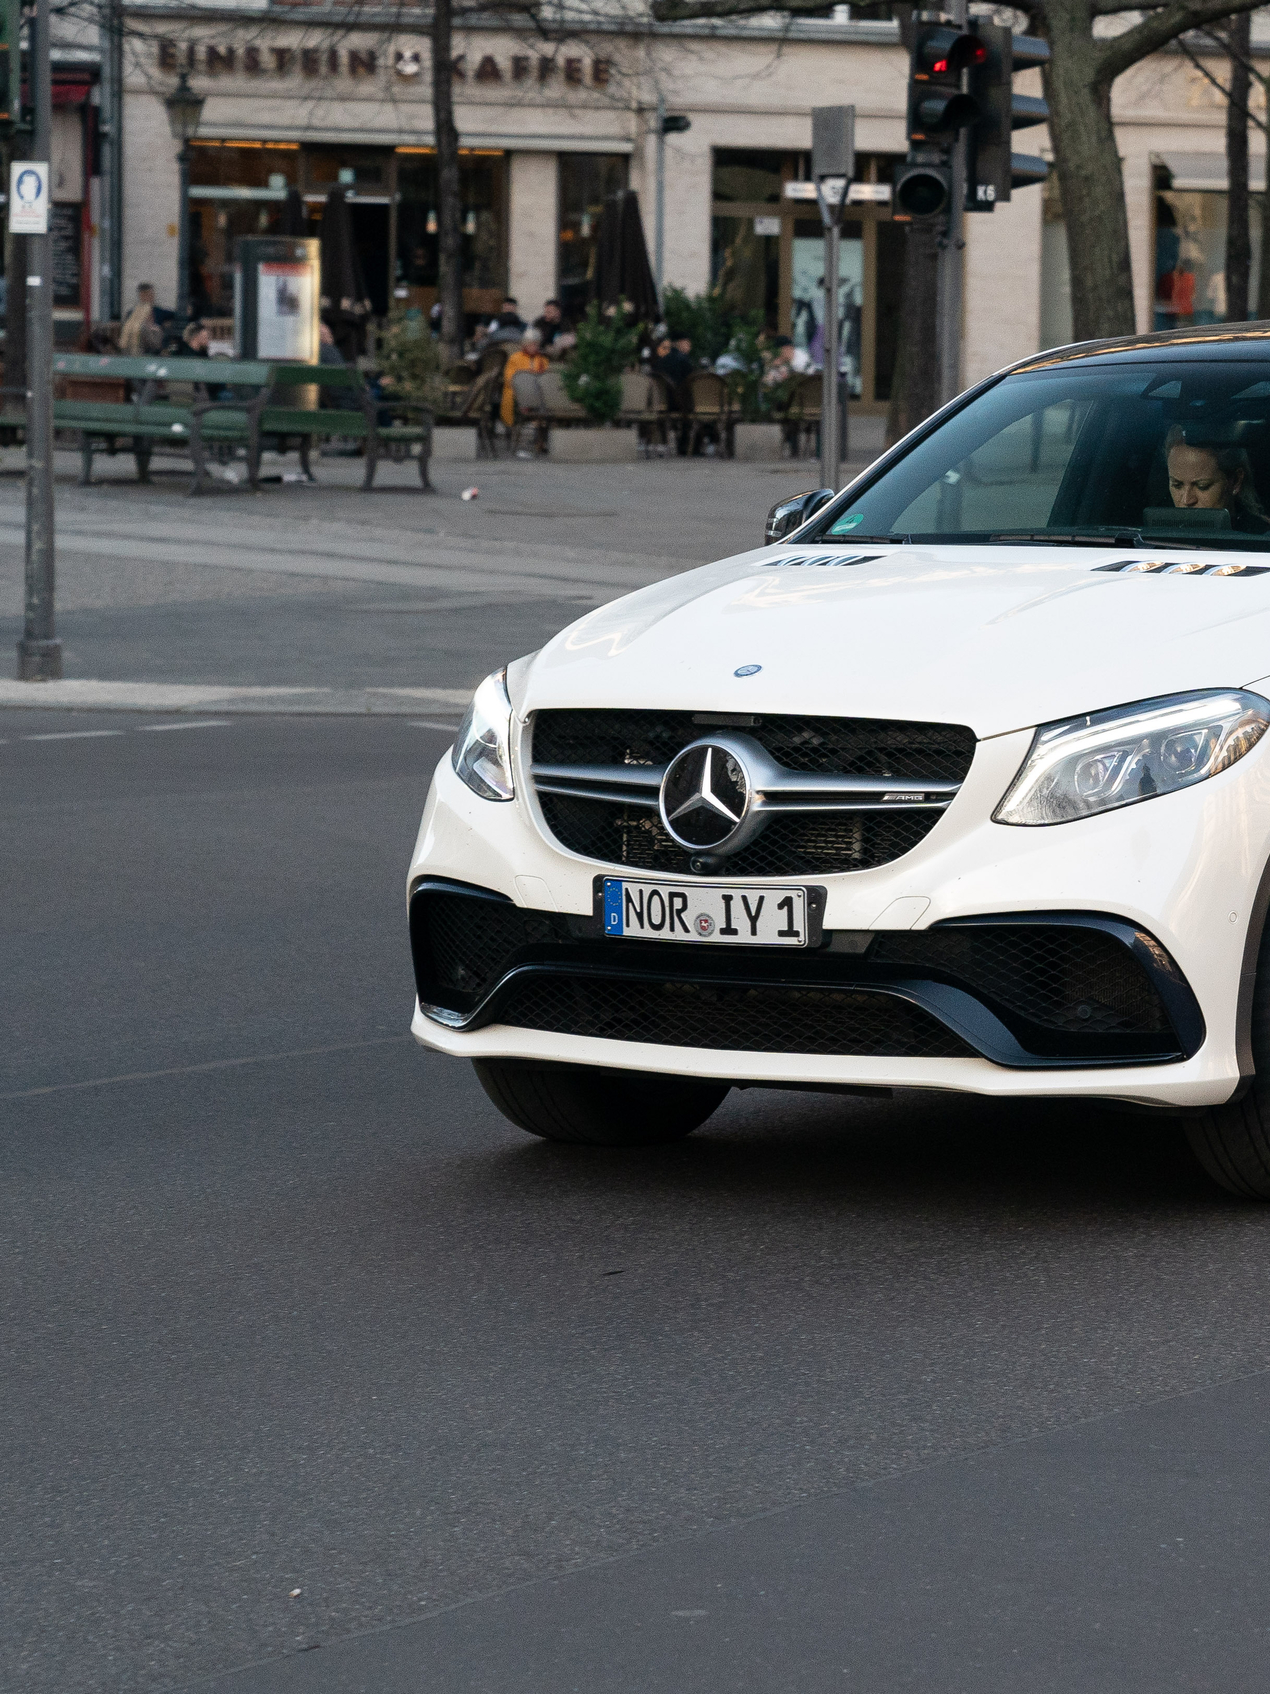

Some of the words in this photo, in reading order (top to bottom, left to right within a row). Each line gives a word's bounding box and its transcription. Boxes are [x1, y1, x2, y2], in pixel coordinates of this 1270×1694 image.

[157, 40, 377, 77] EINSTEIN
[976, 184, 996, 201] K6
[610, 912, 619, 925] D
[625, 887, 691, 933] NOR
[719, 893, 765, 937] IY
[777, 896, 800, 938] 1
